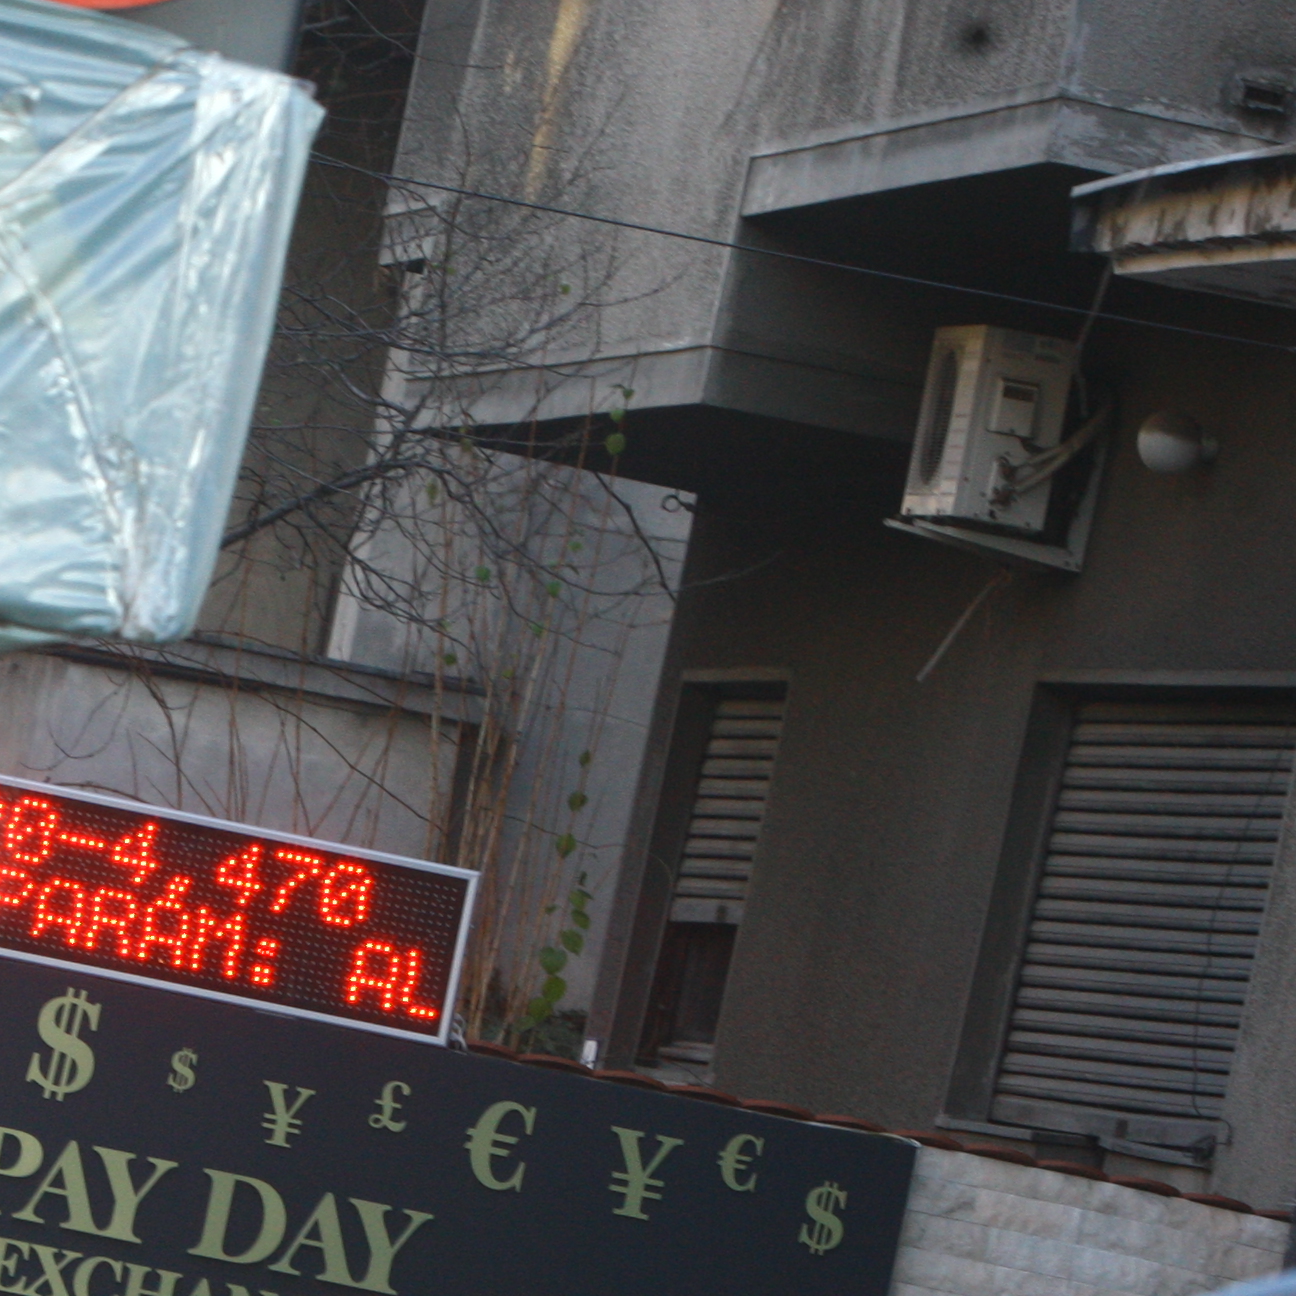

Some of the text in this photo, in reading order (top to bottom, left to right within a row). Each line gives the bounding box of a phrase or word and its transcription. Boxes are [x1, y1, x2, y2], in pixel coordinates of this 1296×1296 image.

[26, 987, 102, 1101] $
[167, 1047, 198, 1093] $
[261, 1080, 315, 1148] ¥
[368, 1081, 411, 1133] £
[464, 1101, 537, 1193] €
[609, 1125, 683, 1221] ¥
[717, 1134, 765, 1192] €
[798, 1181, 848, 1256] $
[186, 1167, 435, 1296] DAY
